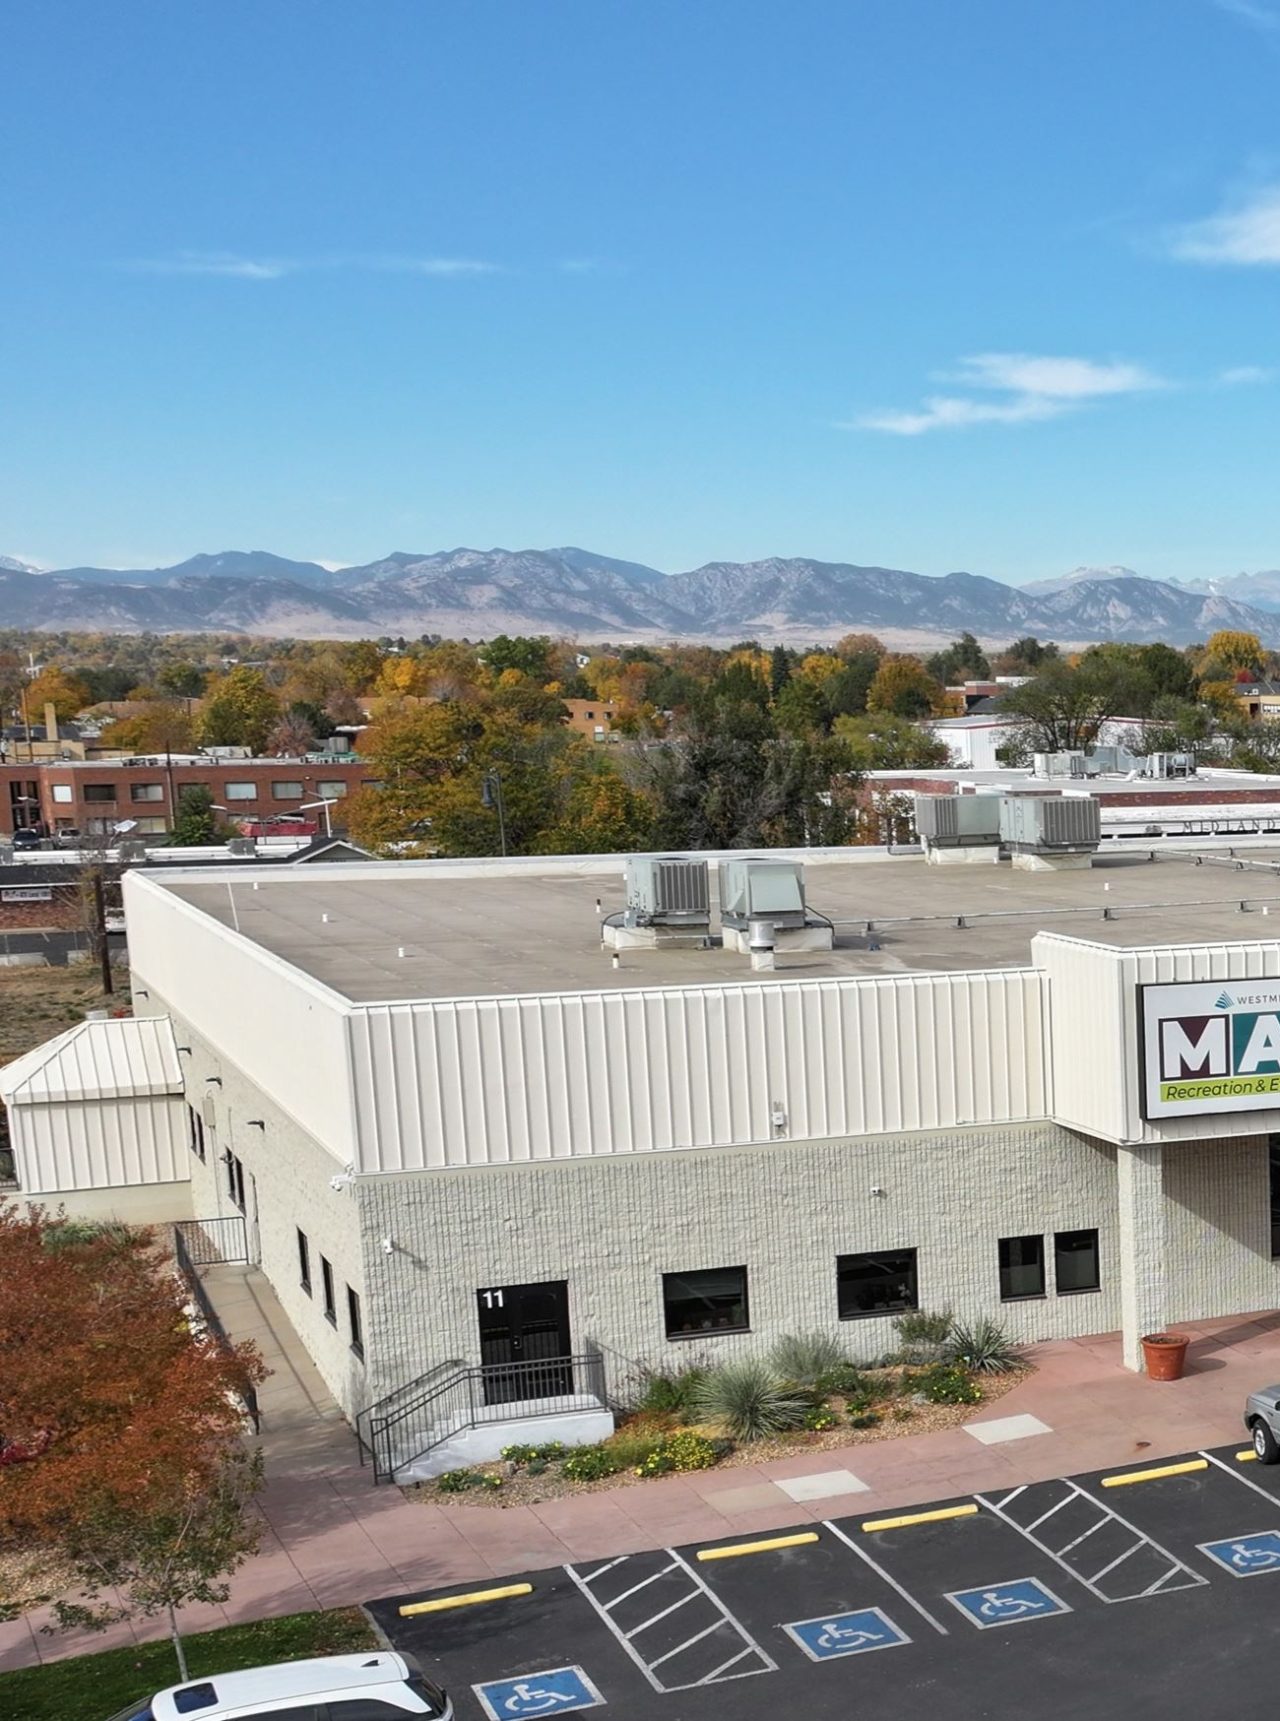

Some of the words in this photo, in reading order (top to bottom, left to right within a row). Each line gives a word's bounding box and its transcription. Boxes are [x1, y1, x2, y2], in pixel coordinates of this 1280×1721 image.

[1182, 819, 1276, 832] MIDLAND
[1166, 1081, 1253, 1100] Recreation
[1255, 1079, 1266, 1093] &
[482, 1290, 504, 1309] 11
